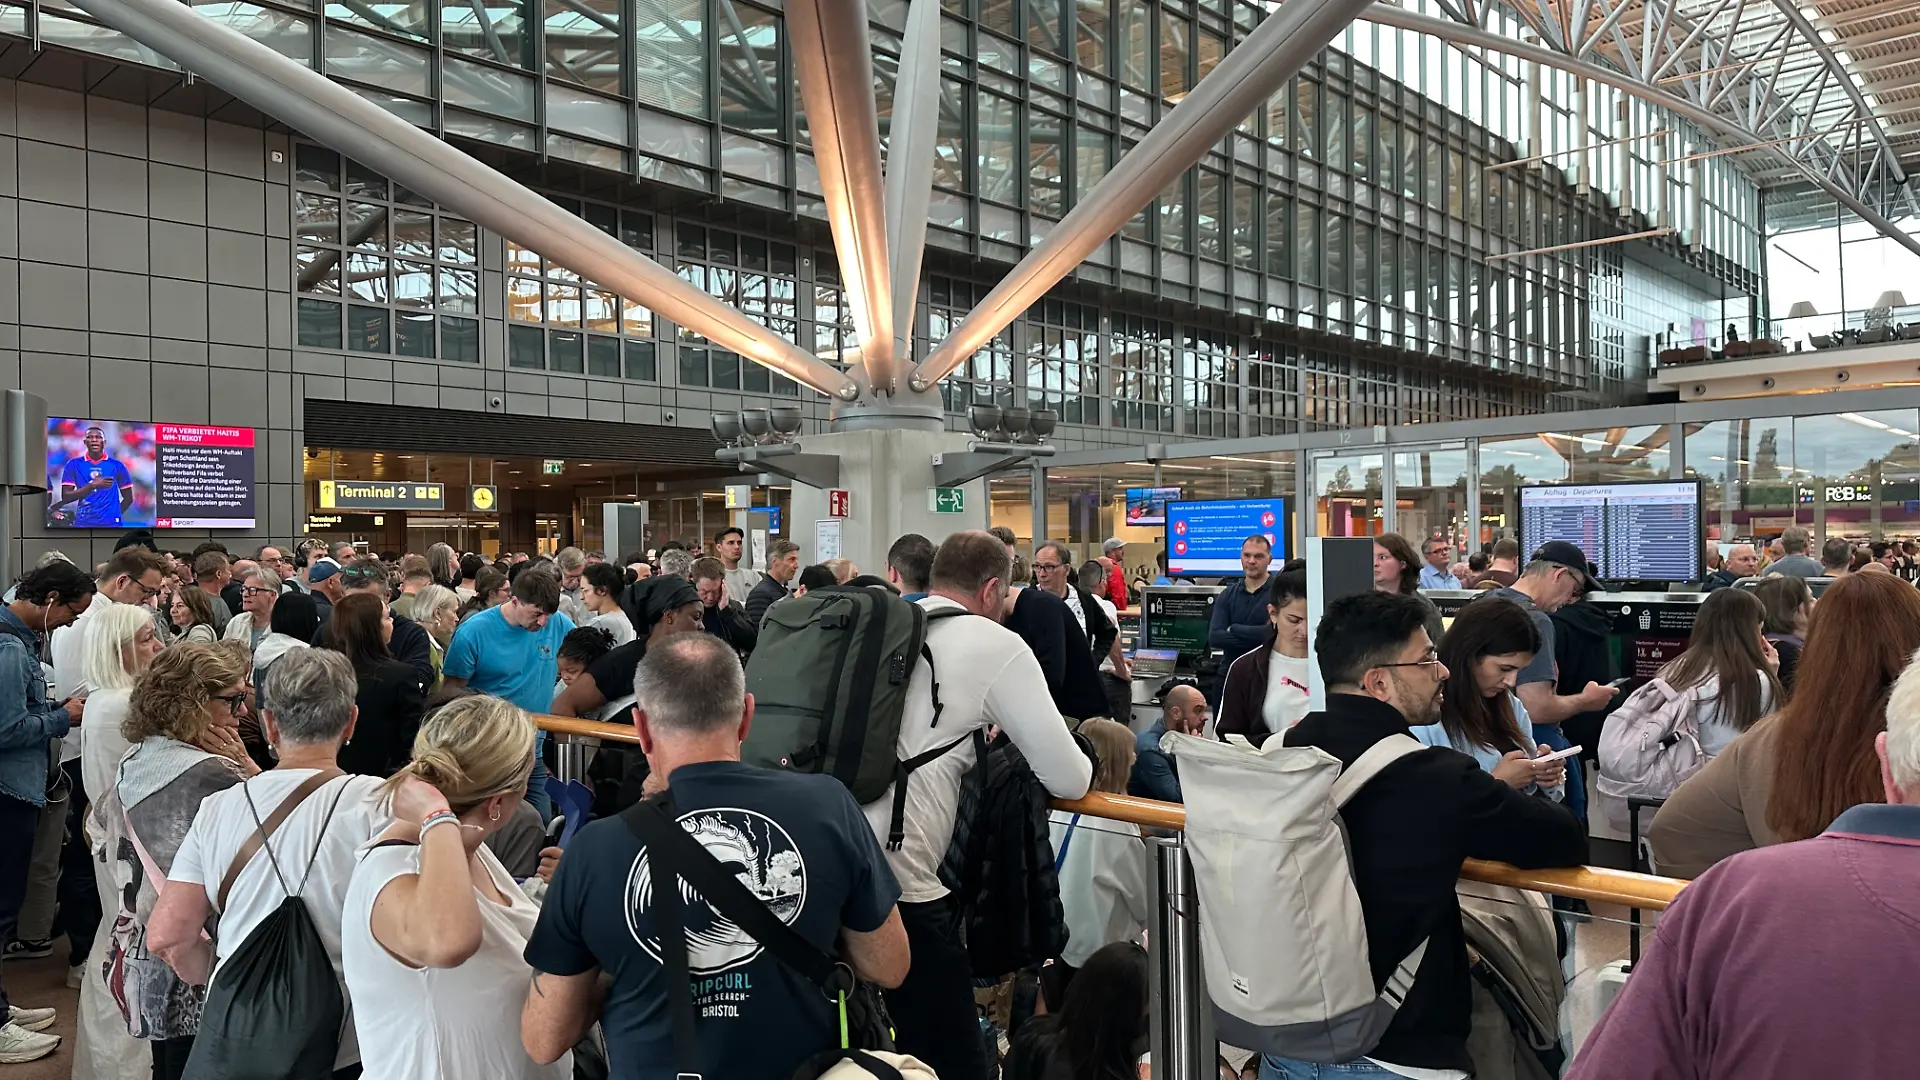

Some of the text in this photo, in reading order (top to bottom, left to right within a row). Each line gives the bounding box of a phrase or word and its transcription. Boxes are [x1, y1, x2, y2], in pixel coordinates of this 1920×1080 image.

[162, 426, 240, 437] FIFA VERBIETET HAITIS
[162, 434, 202, 442] WM-TRIKOT
[1340, 431, 1351, 444] 12
[336, 484, 407, 499] Terminal 2
[1544, 487, 1612, 497] Abflug Departures
[690, 972, 752, 997] RIPCURL
[702, 1004, 739, 1017] BRISTOL
